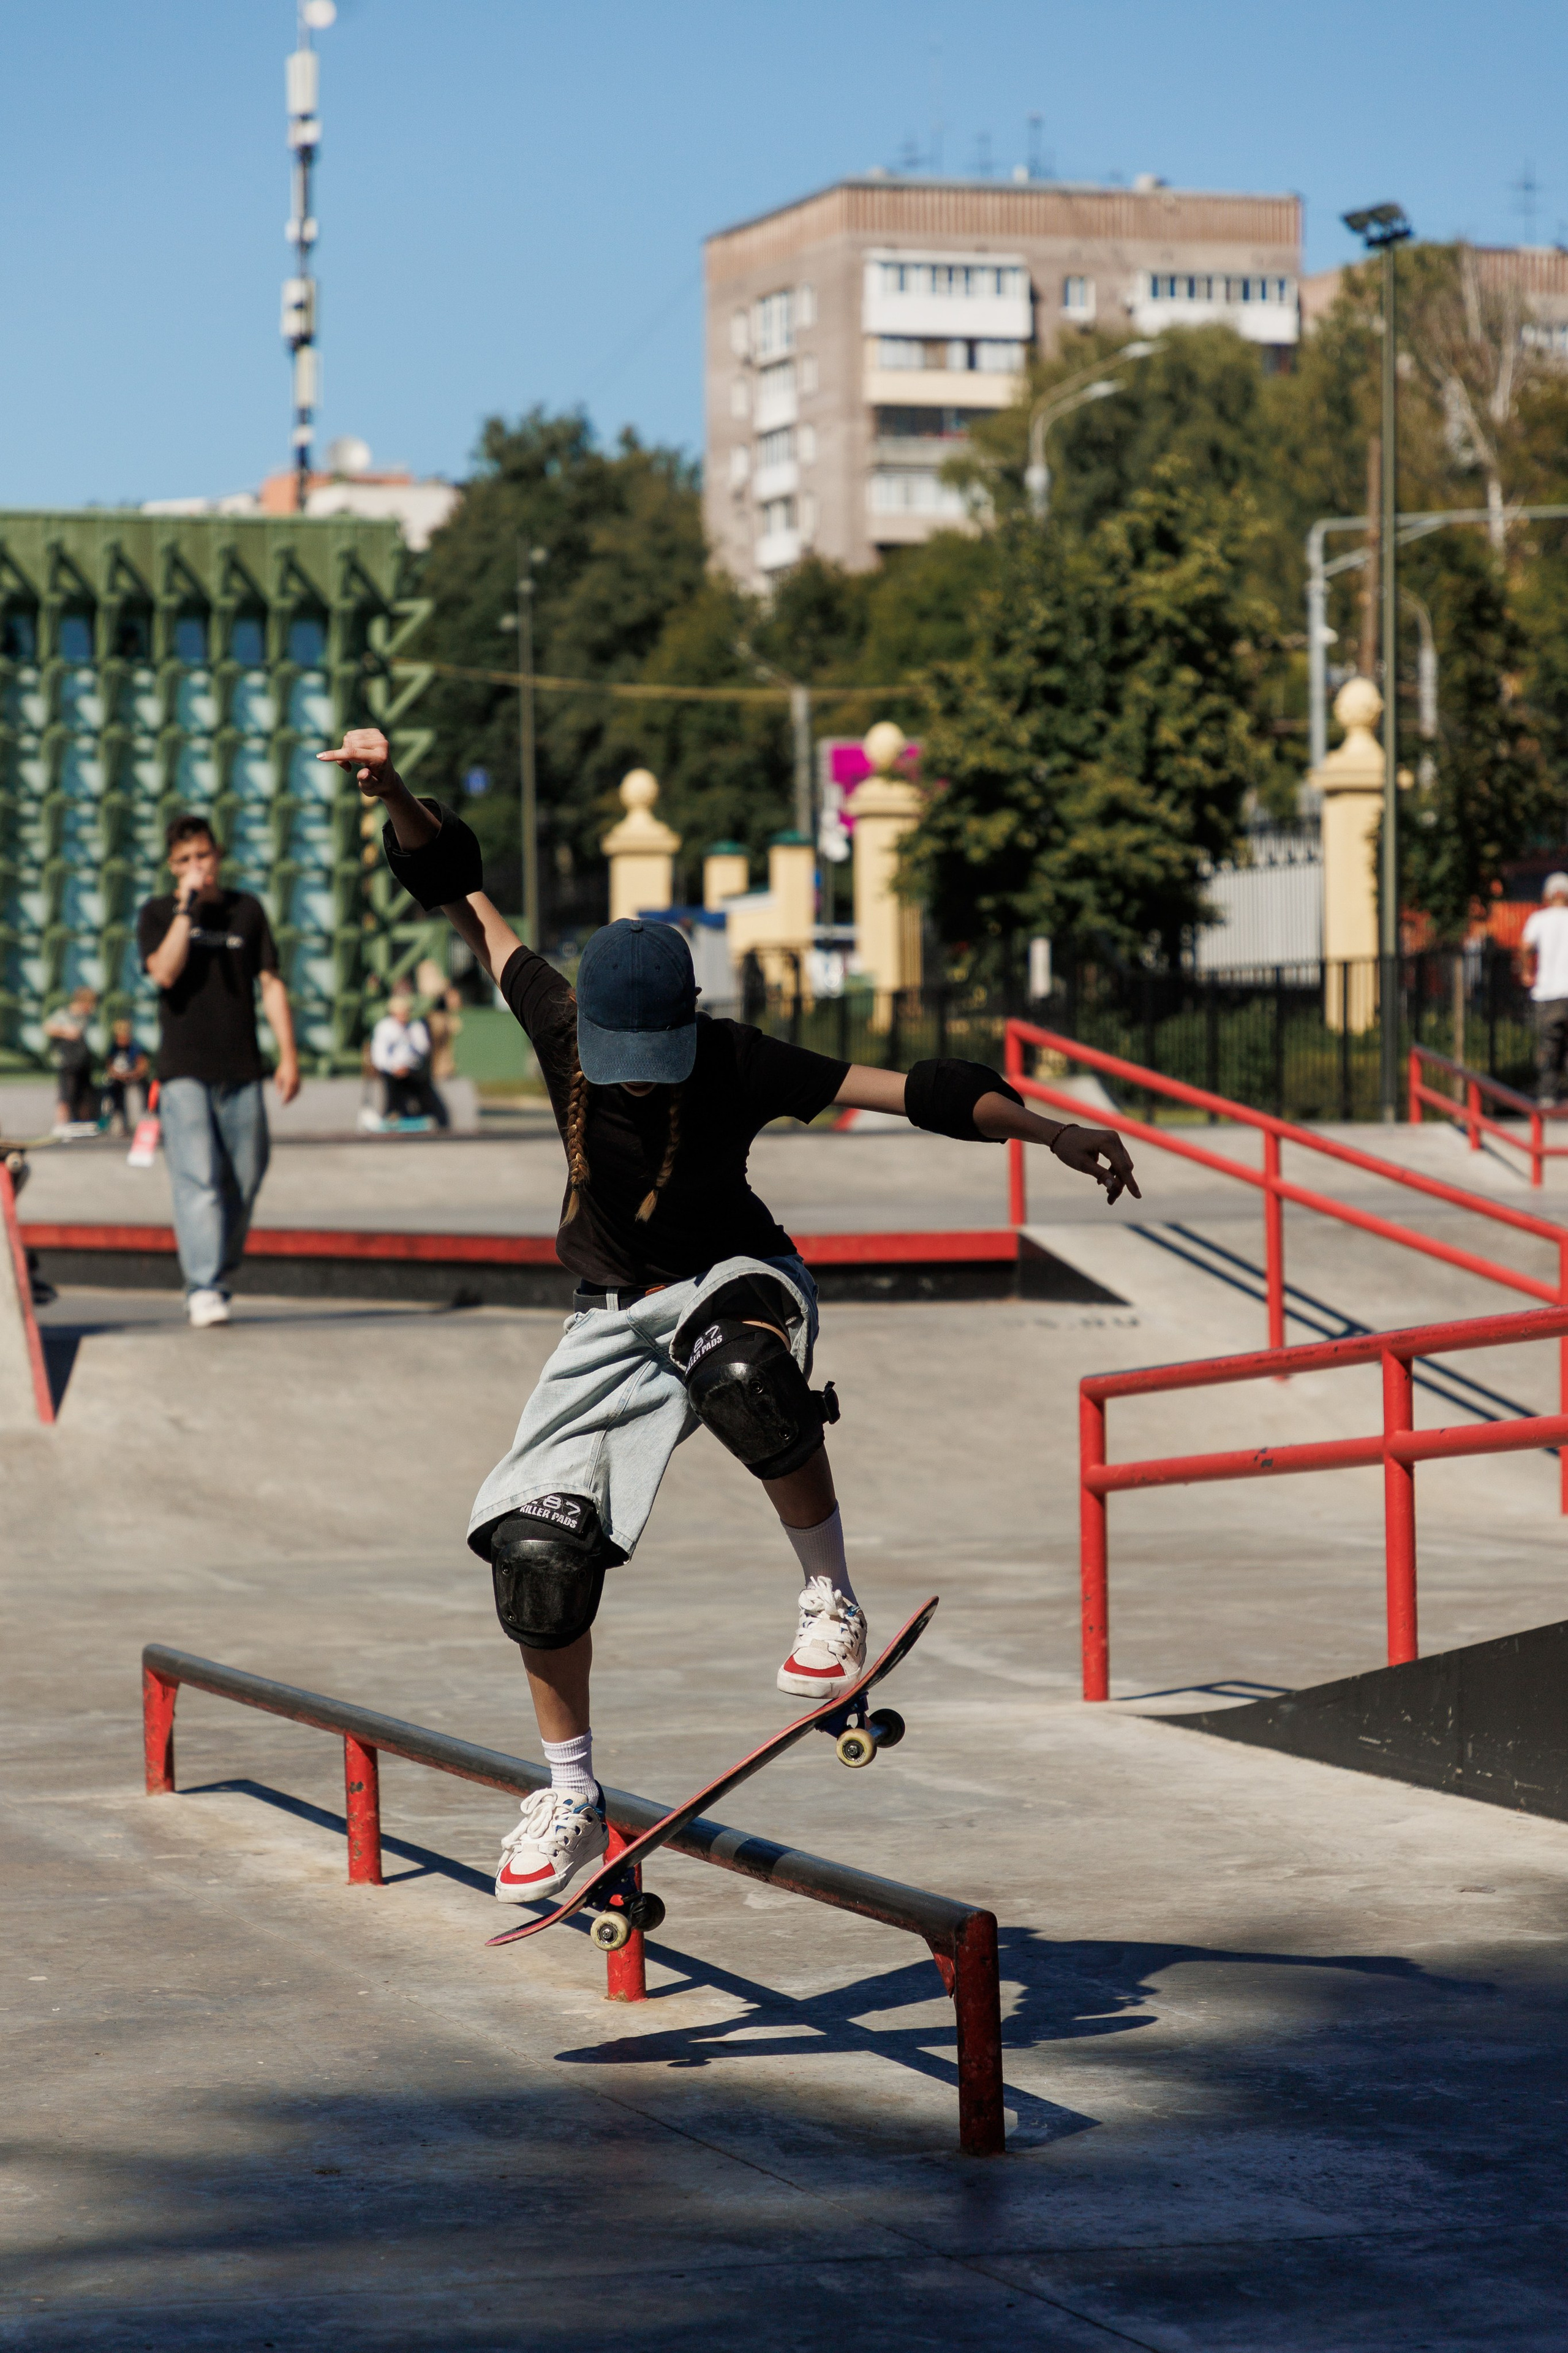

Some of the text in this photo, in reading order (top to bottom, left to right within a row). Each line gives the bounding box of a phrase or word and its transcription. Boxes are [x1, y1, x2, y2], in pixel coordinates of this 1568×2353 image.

[701, 1335, 723, 1354] PADS
[532, 1495, 581, 1516] 87
[519, 1505, 578, 1528] KILLER PADS
